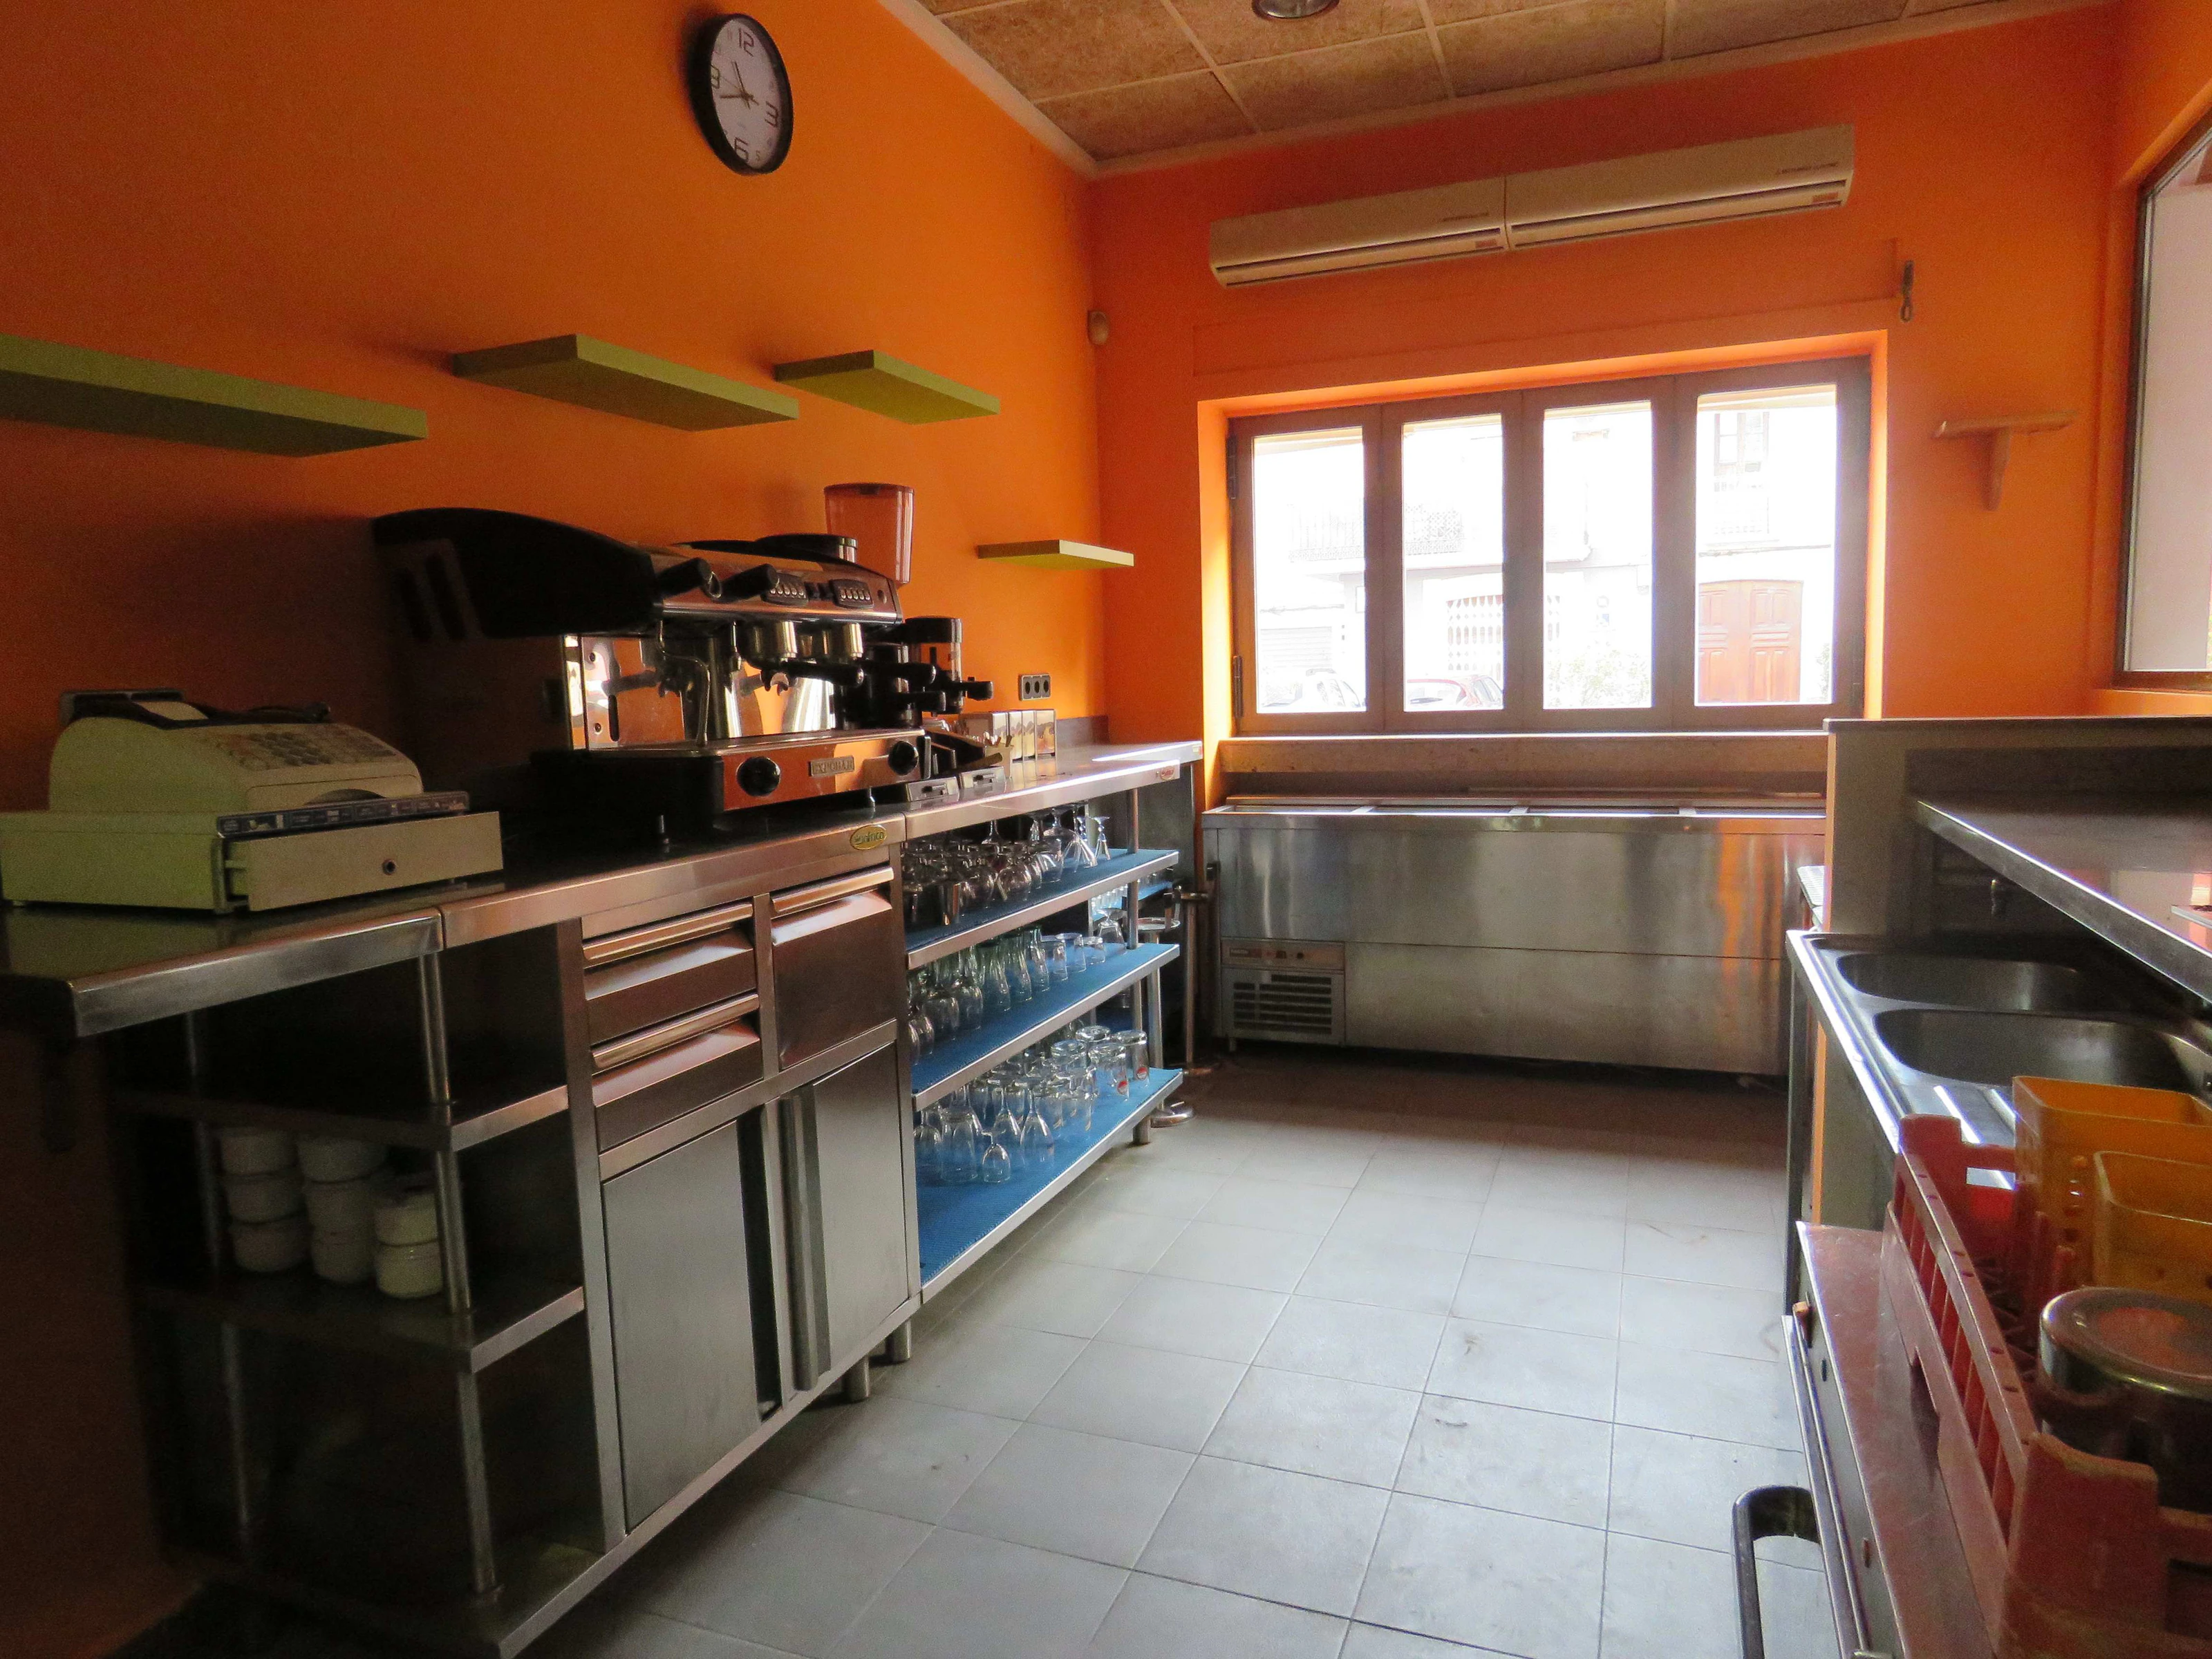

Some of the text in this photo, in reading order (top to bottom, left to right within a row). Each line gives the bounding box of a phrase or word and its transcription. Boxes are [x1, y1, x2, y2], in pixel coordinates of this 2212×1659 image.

[739, 28, 754, 57] 12
[765, 101, 778, 127] 3
[734, 137, 749, 163] 6
